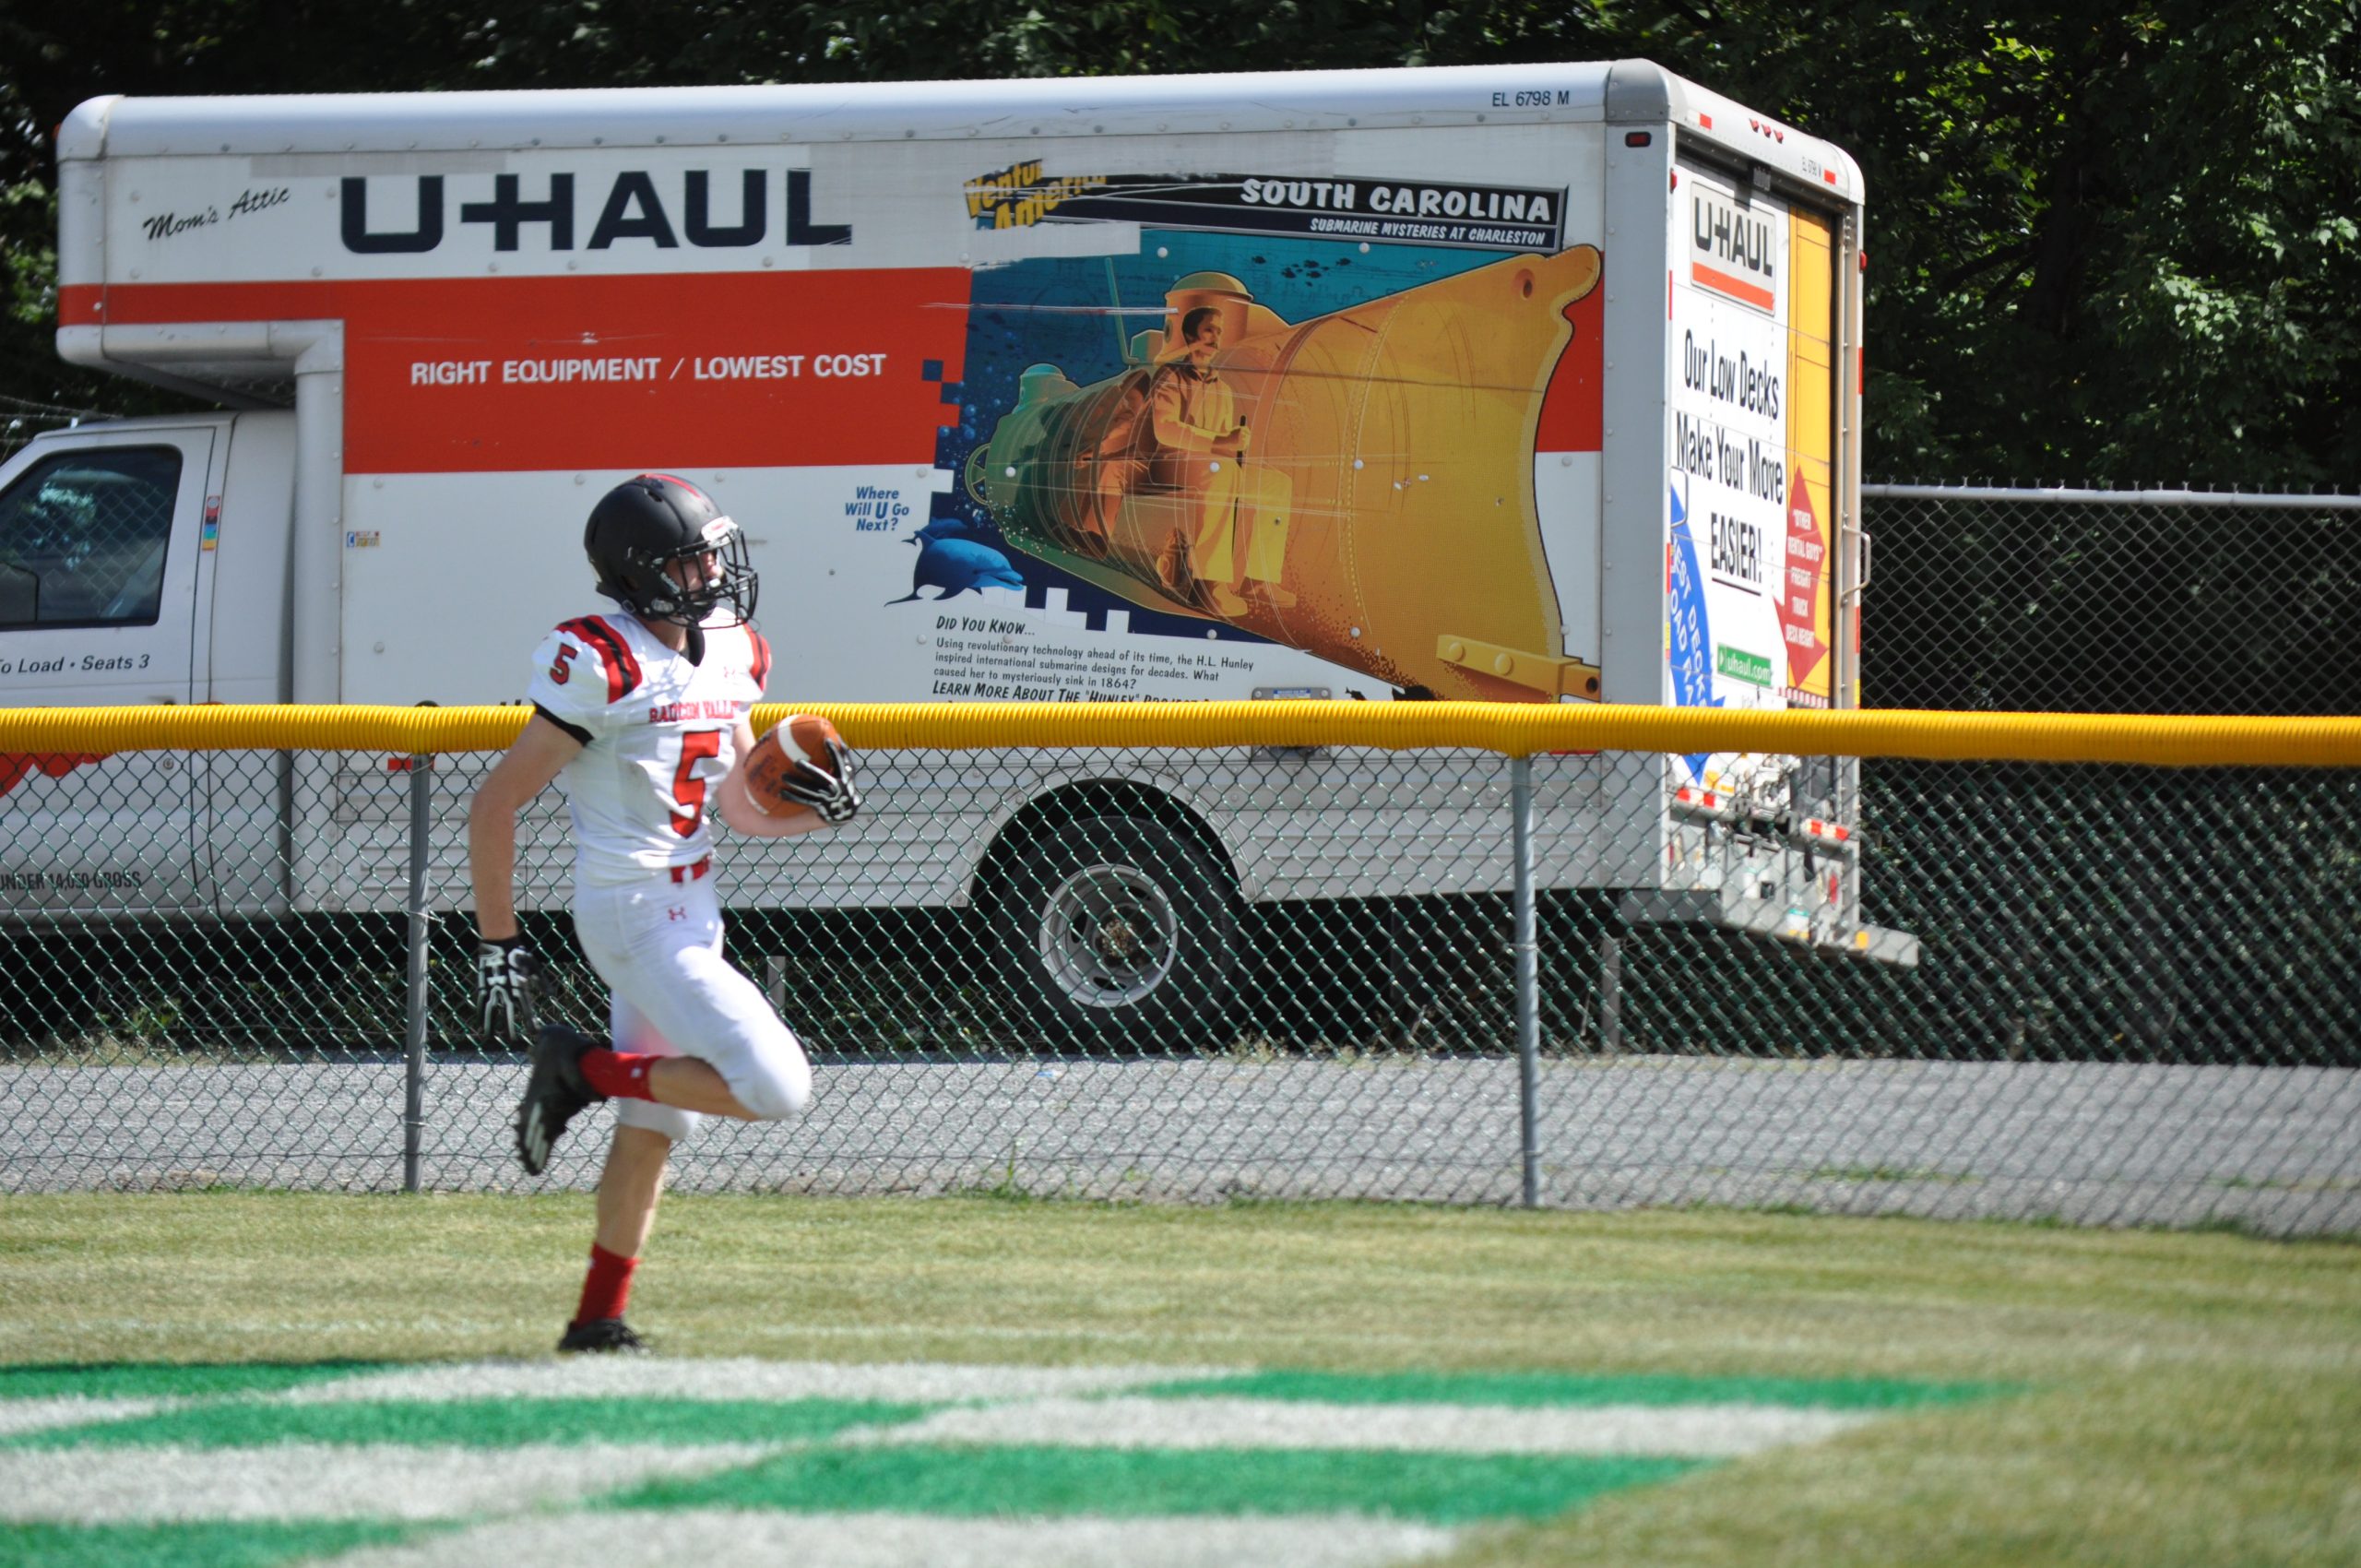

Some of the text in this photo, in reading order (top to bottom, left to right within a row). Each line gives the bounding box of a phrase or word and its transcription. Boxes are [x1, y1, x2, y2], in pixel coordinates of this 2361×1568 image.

[1491, 89, 1570, 107] EL 6798 M
[143, 186, 291, 241] Mom's Attic
[1240, 178, 1551, 221] SOUTH CAROLINA
[1310, 218, 1546, 246] SUBMARINE MYSTERIES AT CHARLESTON
[410, 361, 492, 386] RIGHT
[503, 358, 660, 384] EQUIPMENT
[694, 355, 804, 380] LOWEST
[813, 353, 886, 377] COST
[1685, 328, 1779, 421] Our Low Decks
[1677, 411, 1783, 505] Make Your Move
[856, 486, 900, 501] Where
[845, 502, 909, 518] Will U Go
[856, 517, 898, 531] Next?
[1711, 512, 1762, 583] EASIER!
[936, 615, 957, 630] DID
[962, 616, 986, 632] YOU
[18, 657, 65, 673] Load
[81, 655, 134, 671] Seats
[138, 654, 150, 669] 3
[550, 643, 578, 685] 5
[935, 652, 1219, 682] inspired international submarine designs for decades. What
[936, 636, 964, 651] Using
[967, 641, 1029, 656] revolutionary
[1033, 645, 1084, 659] technology
[1087, 647, 1115, 659] ahead
[1119, 649, 1130, 660] of
[1133, 650, 1145, 662] its
[1149, 652, 1173, 665] time,
[1178, 653, 1192, 665] the
[1221, 657, 1254, 672] Hunley
[1727, 652, 1771, 681] uhaul.com
[932, 680, 971, 696] LEARN
[974, 683, 1010, 699] MORE
[1013, 685, 1055, 702] ABOUT
[1058, 688, 1081, 703] THE
[934, 667, 1137, 690] caused her to mysteriously sink in 1864?
[670, 730, 720, 838] 5
[93, 871, 142, 888] GROSS
